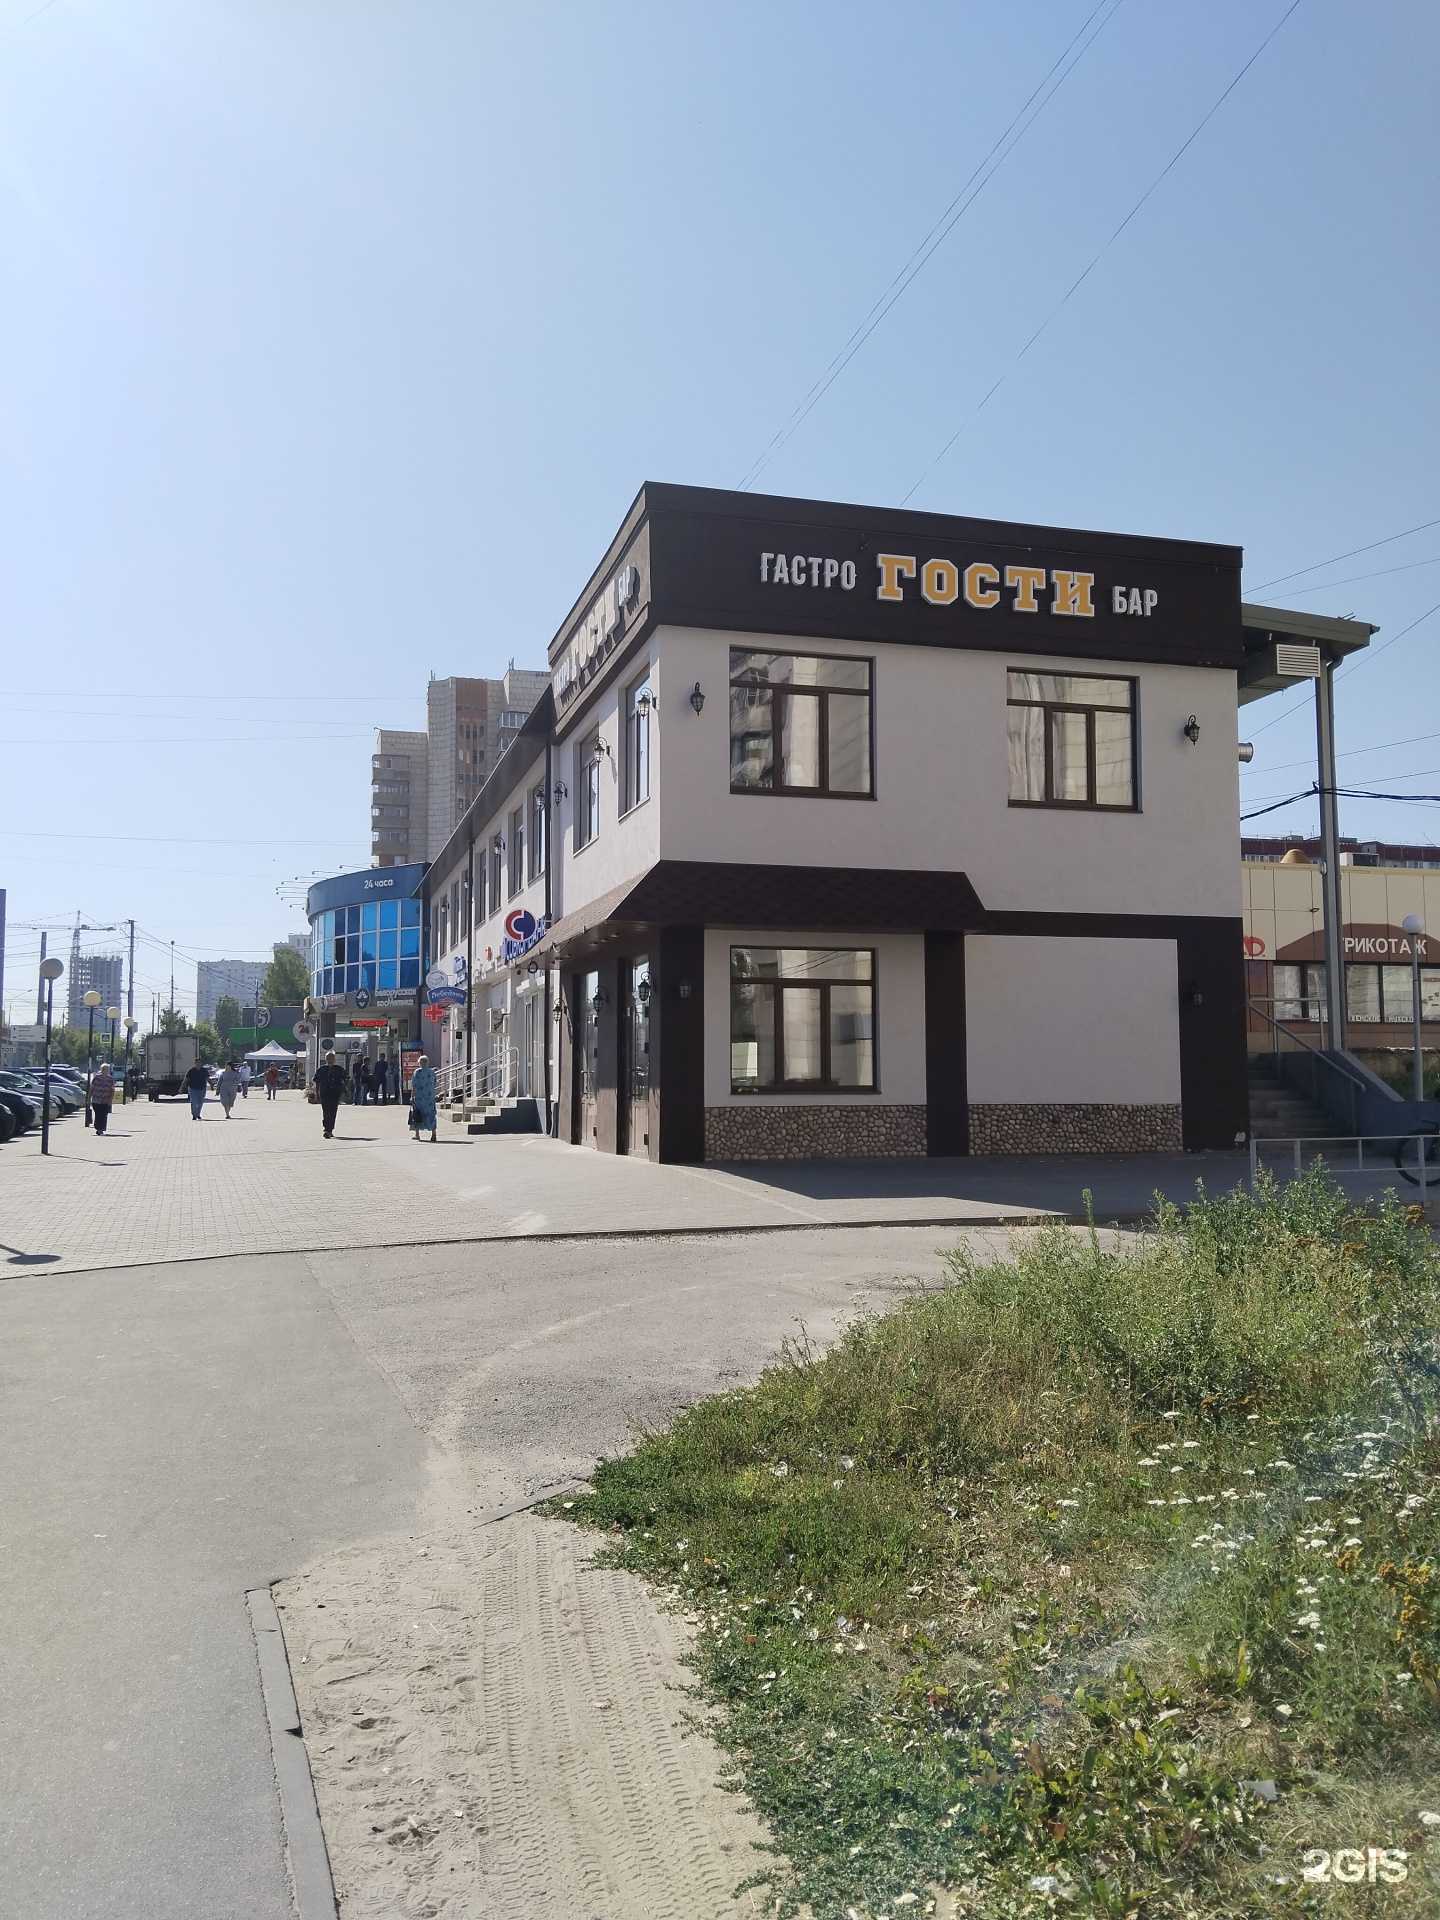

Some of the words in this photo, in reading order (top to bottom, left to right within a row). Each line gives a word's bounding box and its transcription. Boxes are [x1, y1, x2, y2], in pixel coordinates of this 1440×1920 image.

[760, 551, 857, 590] ГАСТРО
[876, 552, 1095, 617] ГОСТИ
[1112, 585, 1158, 617] БАР
[363, 879, 374, 889] 24
[374, 879, 394, 888] часа
[1342, 937, 1427, 955] РИКОТАЖ
